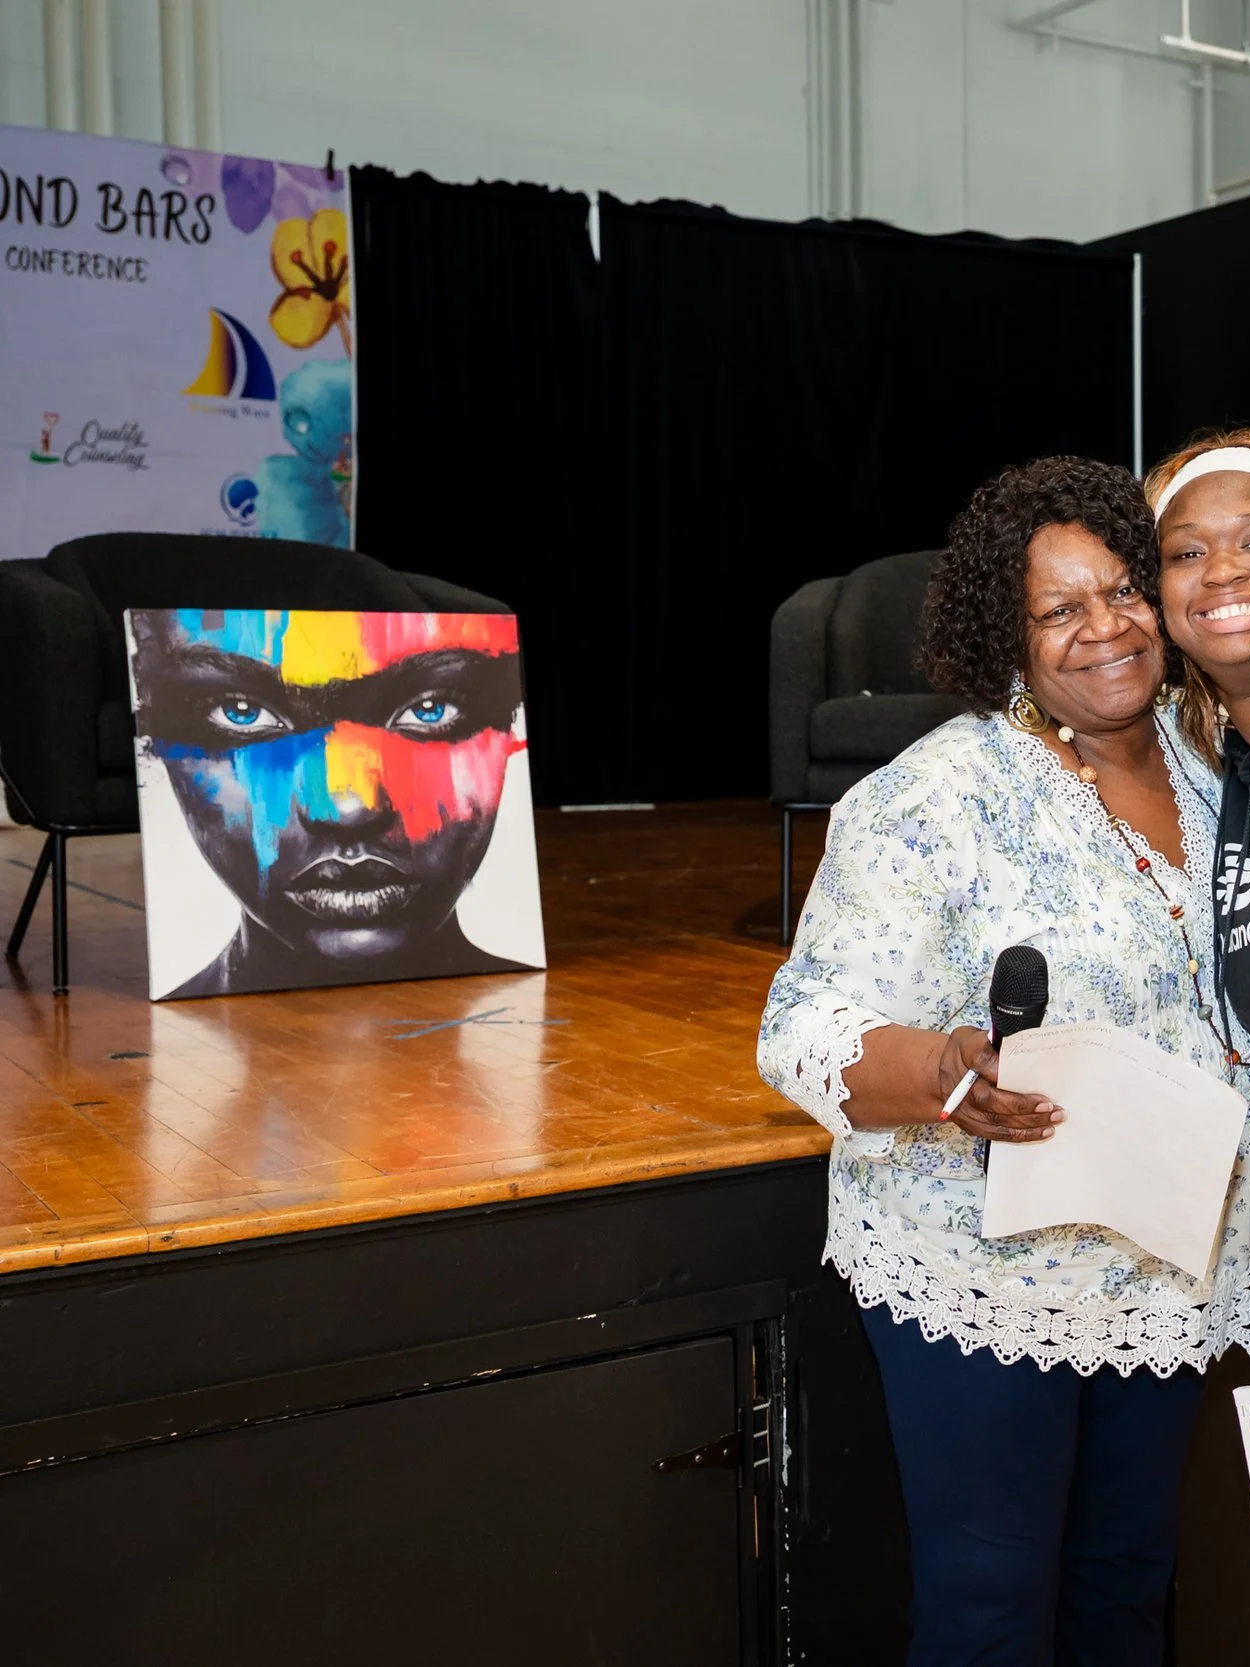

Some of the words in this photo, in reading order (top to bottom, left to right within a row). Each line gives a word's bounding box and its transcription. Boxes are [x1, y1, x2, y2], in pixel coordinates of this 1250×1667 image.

[97, 181, 217, 244] BARS
[5, 245, 149, 283] CONFERENCE
[80, 419, 149, 449] Quality
